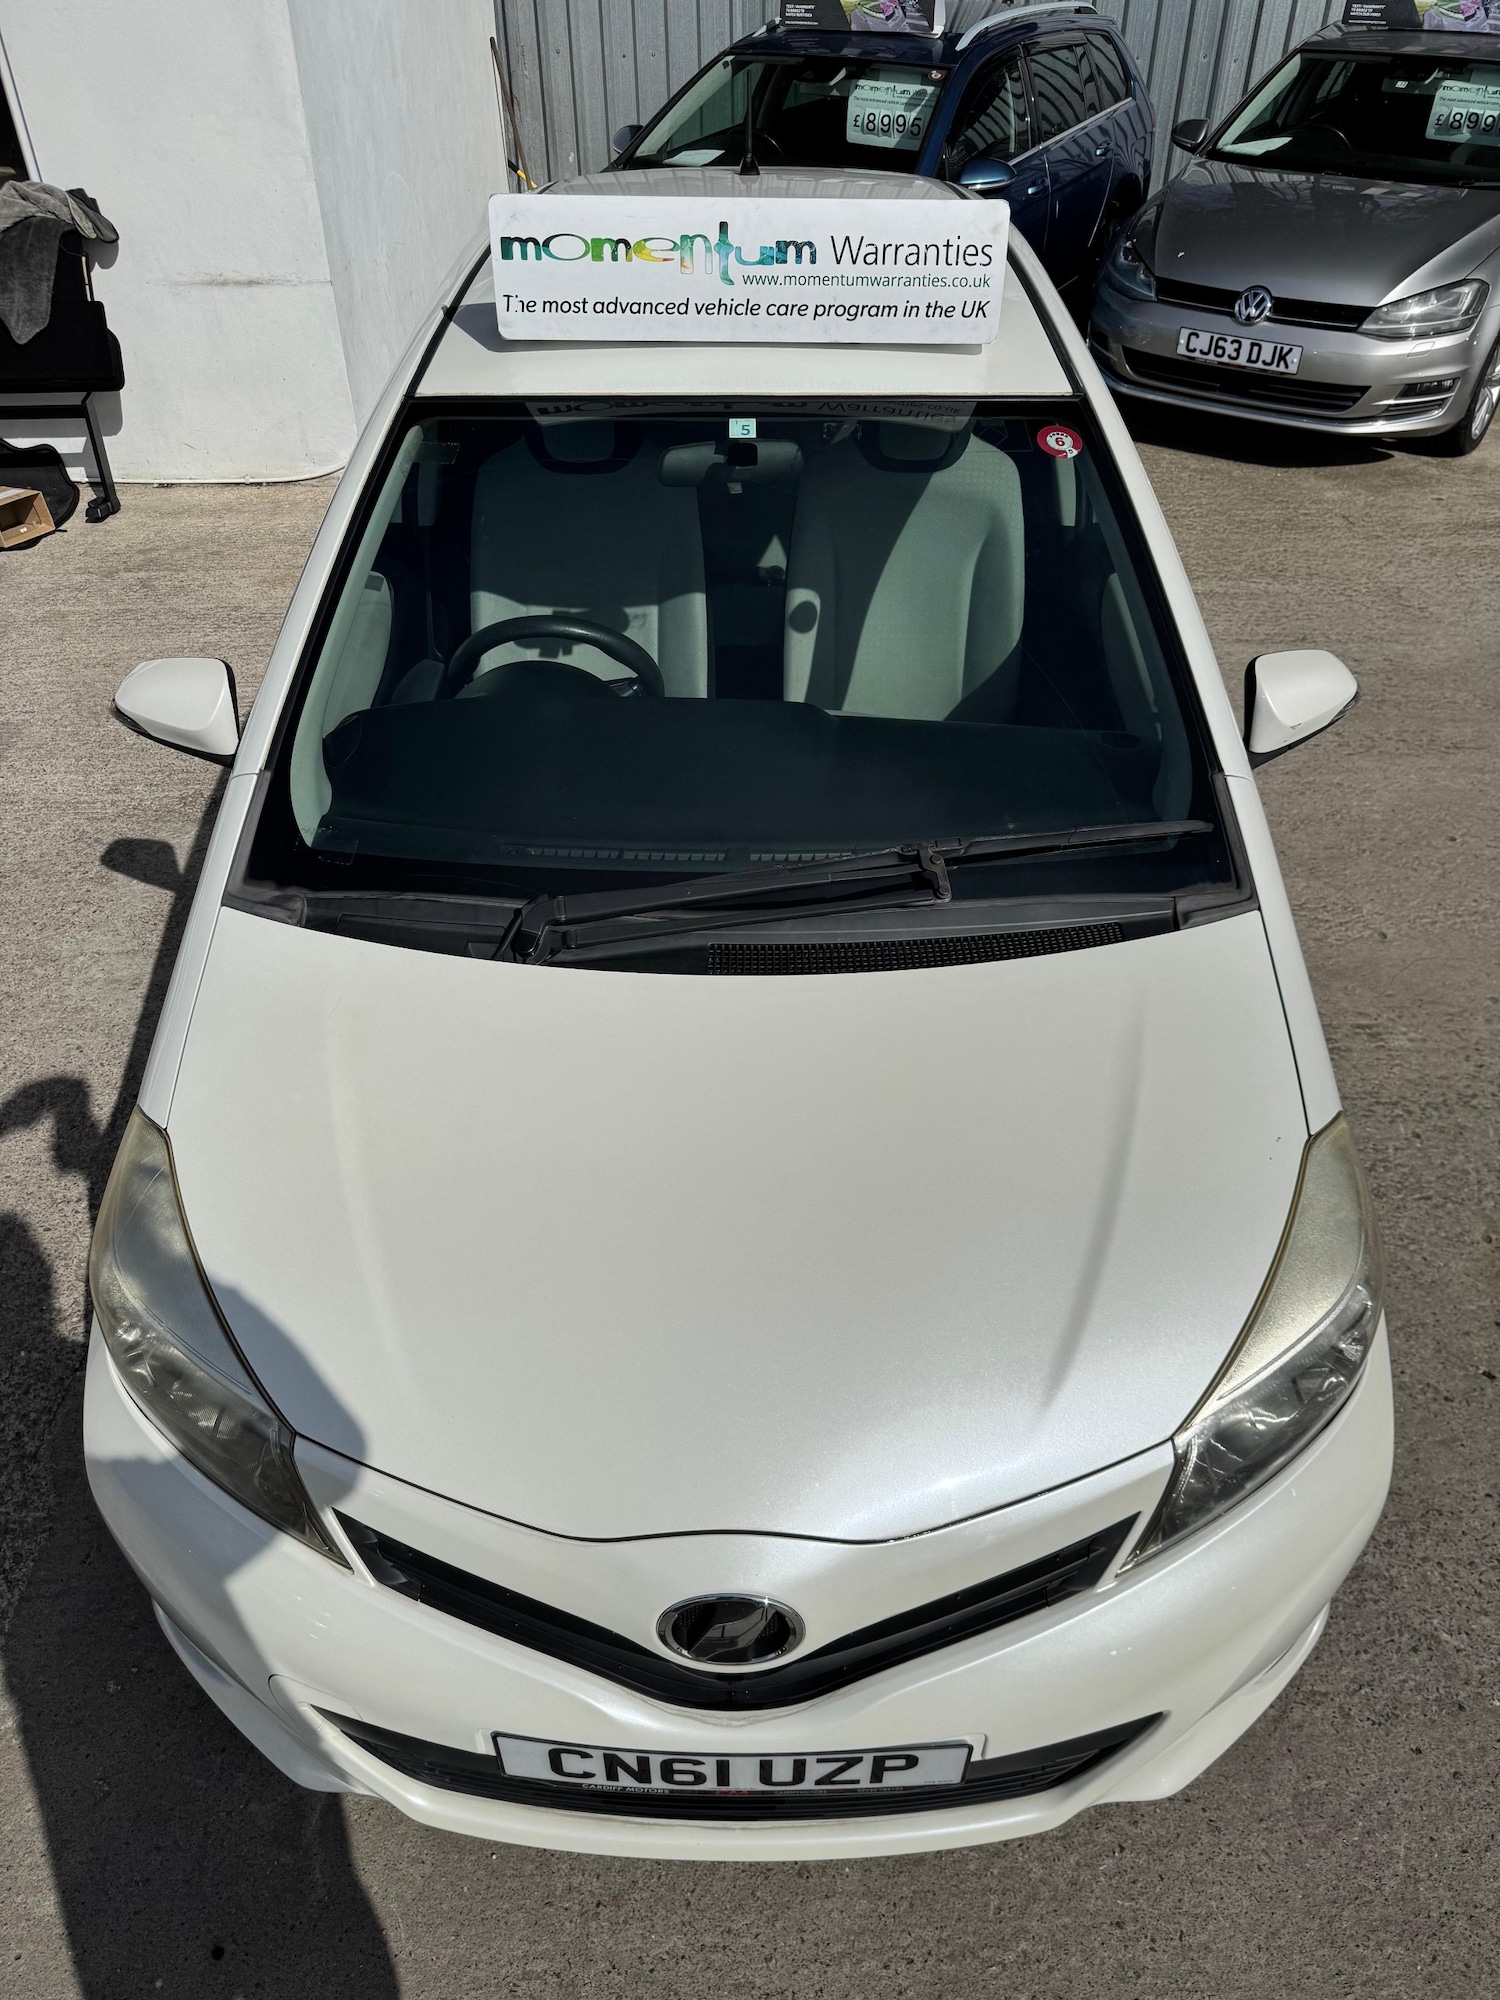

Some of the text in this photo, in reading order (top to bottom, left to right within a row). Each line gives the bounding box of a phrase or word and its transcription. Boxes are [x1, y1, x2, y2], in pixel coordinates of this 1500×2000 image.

[1434, 112, 1500, 133] £899
[500, 221, 993, 286] momentum Warranties
[742, 273, 991, 288] www.momentumwarranties.co.uk
[542, 297, 588, 314] most
[593, 297, 689, 315] advanced
[694, 298, 761, 316] vehicle
[766, 302, 809, 318] care
[813, 303, 898, 321] program
[903, 300, 919, 318] in
[925, 301, 956, 319] the
[961, 300, 991, 319] UK
[1185, 332, 1294, 370] CJ63 DJK
[741, 424, 751, 436] 5
[1055, 437, 1065, 447] 6
[549, 1747, 921, 1788] CN61 UZP
[582, 1783, 670, 1794] CARDIFF MOTORS
